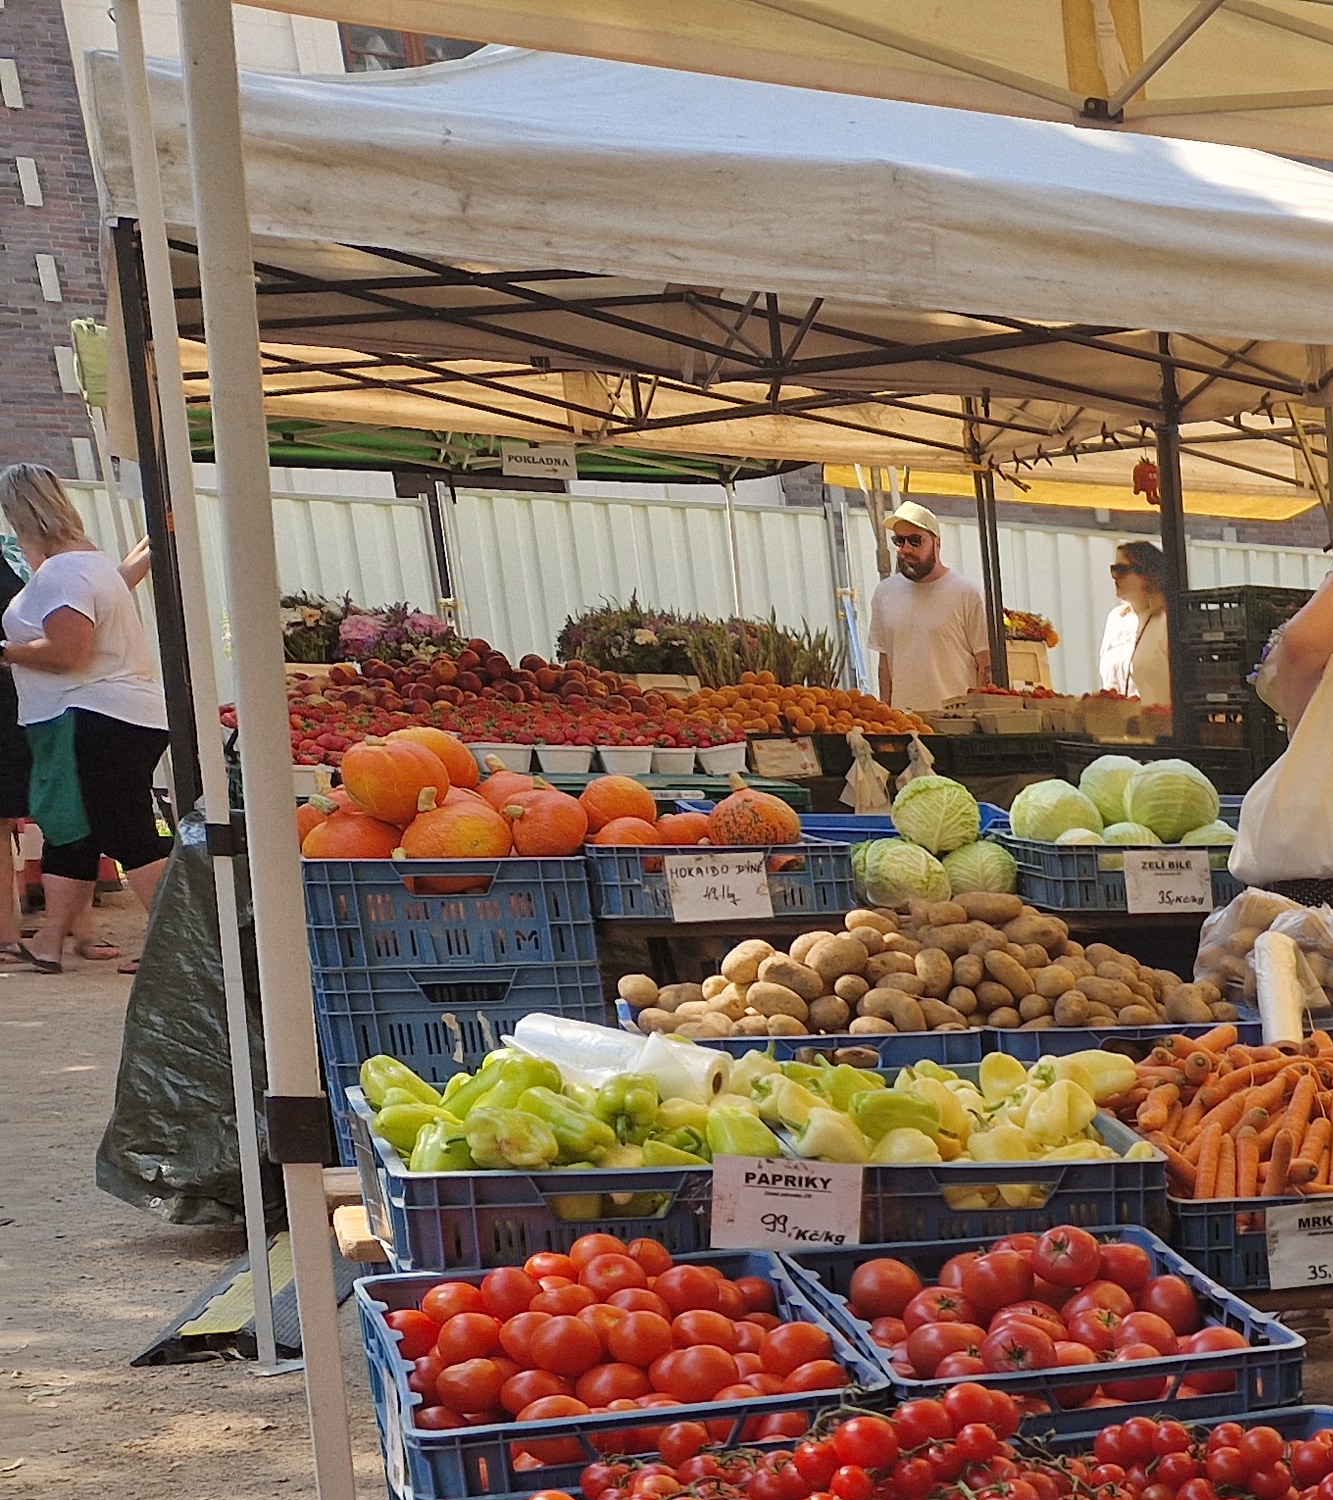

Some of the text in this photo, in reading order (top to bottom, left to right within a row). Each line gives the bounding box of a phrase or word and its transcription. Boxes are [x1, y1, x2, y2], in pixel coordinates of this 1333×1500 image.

[507, 455, 569, 467] POKLADNA
[1141, 860, 1166, 870] ZELÍ
[744, 1171, 833, 1190] PAPRIKY
[794, 1229, 847, 1246] Kč/kg
